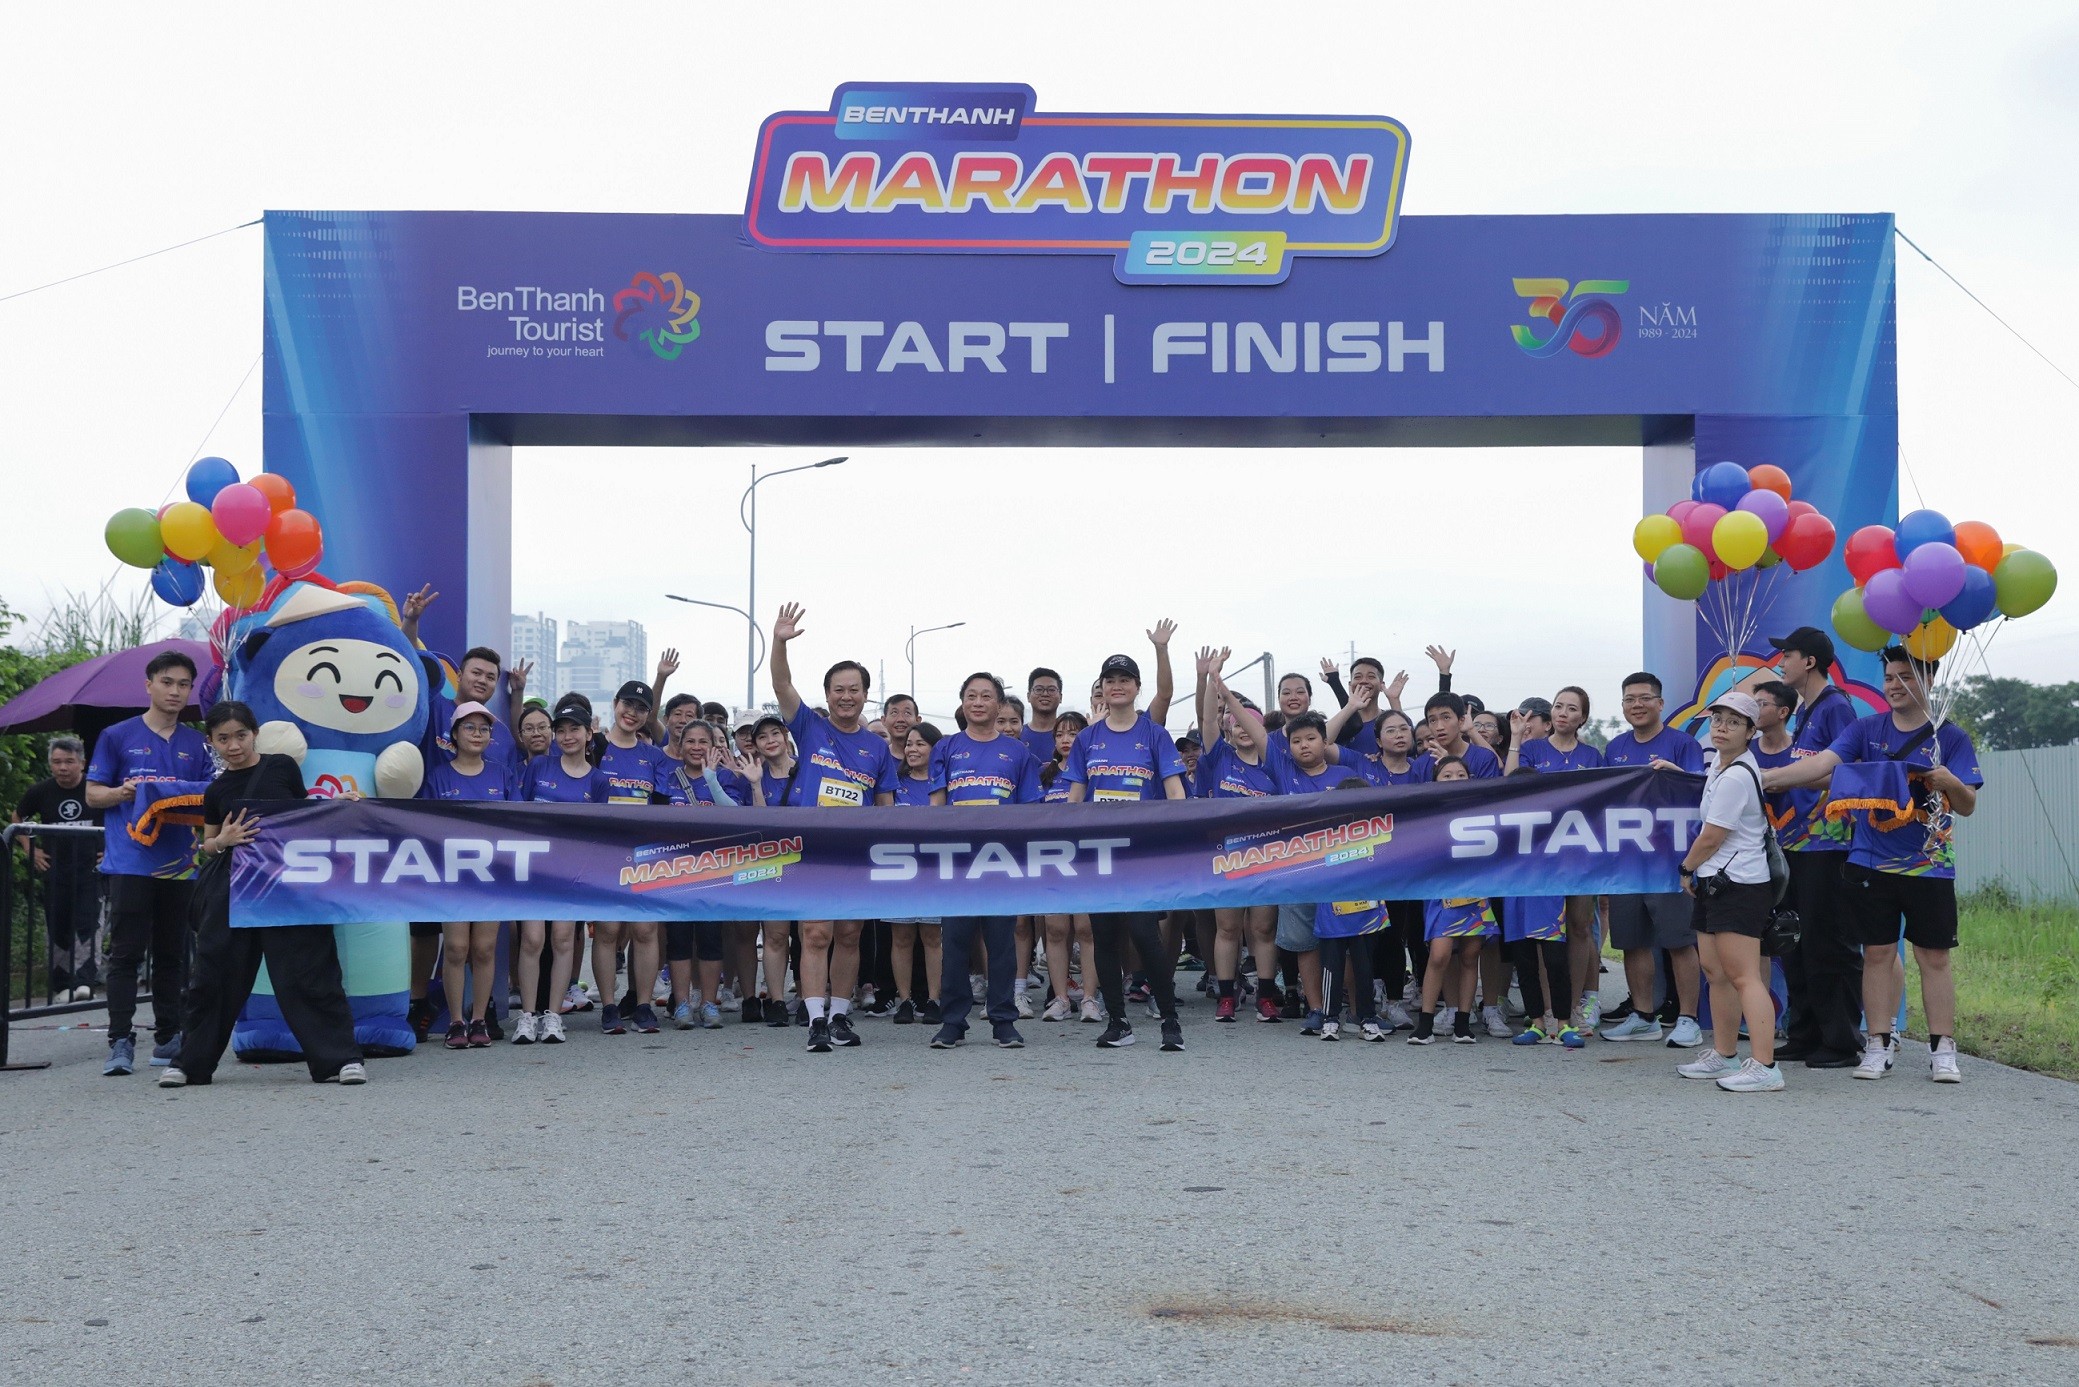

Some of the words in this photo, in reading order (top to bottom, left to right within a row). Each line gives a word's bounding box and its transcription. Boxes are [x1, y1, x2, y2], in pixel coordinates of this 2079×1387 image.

[843, 106, 1015, 127] BENTHANH
[778, 151, 1374, 215] MARATHON
[1145, 240, 1269, 267] 2024
[1639, 301, 1698, 326] NĂM
[508, 316, 604, 342] Tourist
[1638, 328, 1663, 339] 1989
[1671, 328, 1698, 339] 2024
[487, 344, 530, 358] journey
[533, 345, 544, 356] to
[547, 347, 572, 358] your
[575, 346, 604, 357] heart
[765, 320, 1069, 374] START
[1153, 320, 1445, 374] FINISH
[825, 785, 859, 802] BT122
[1213, 813, 1393, 875] MARATHON
[1226, 828, 1280, 845] BENTHANH
[1449, 807, 1704, 859] START
[281, 838, 550, 884] START
[619, 836, 802, 886] MARATHON
[636, 842, 690, 858] BENTHANH
[869, 837, 1131, 881] START
[1329, 846, 1369, 863] 2024
[737, 865, 778, 882] 2024
